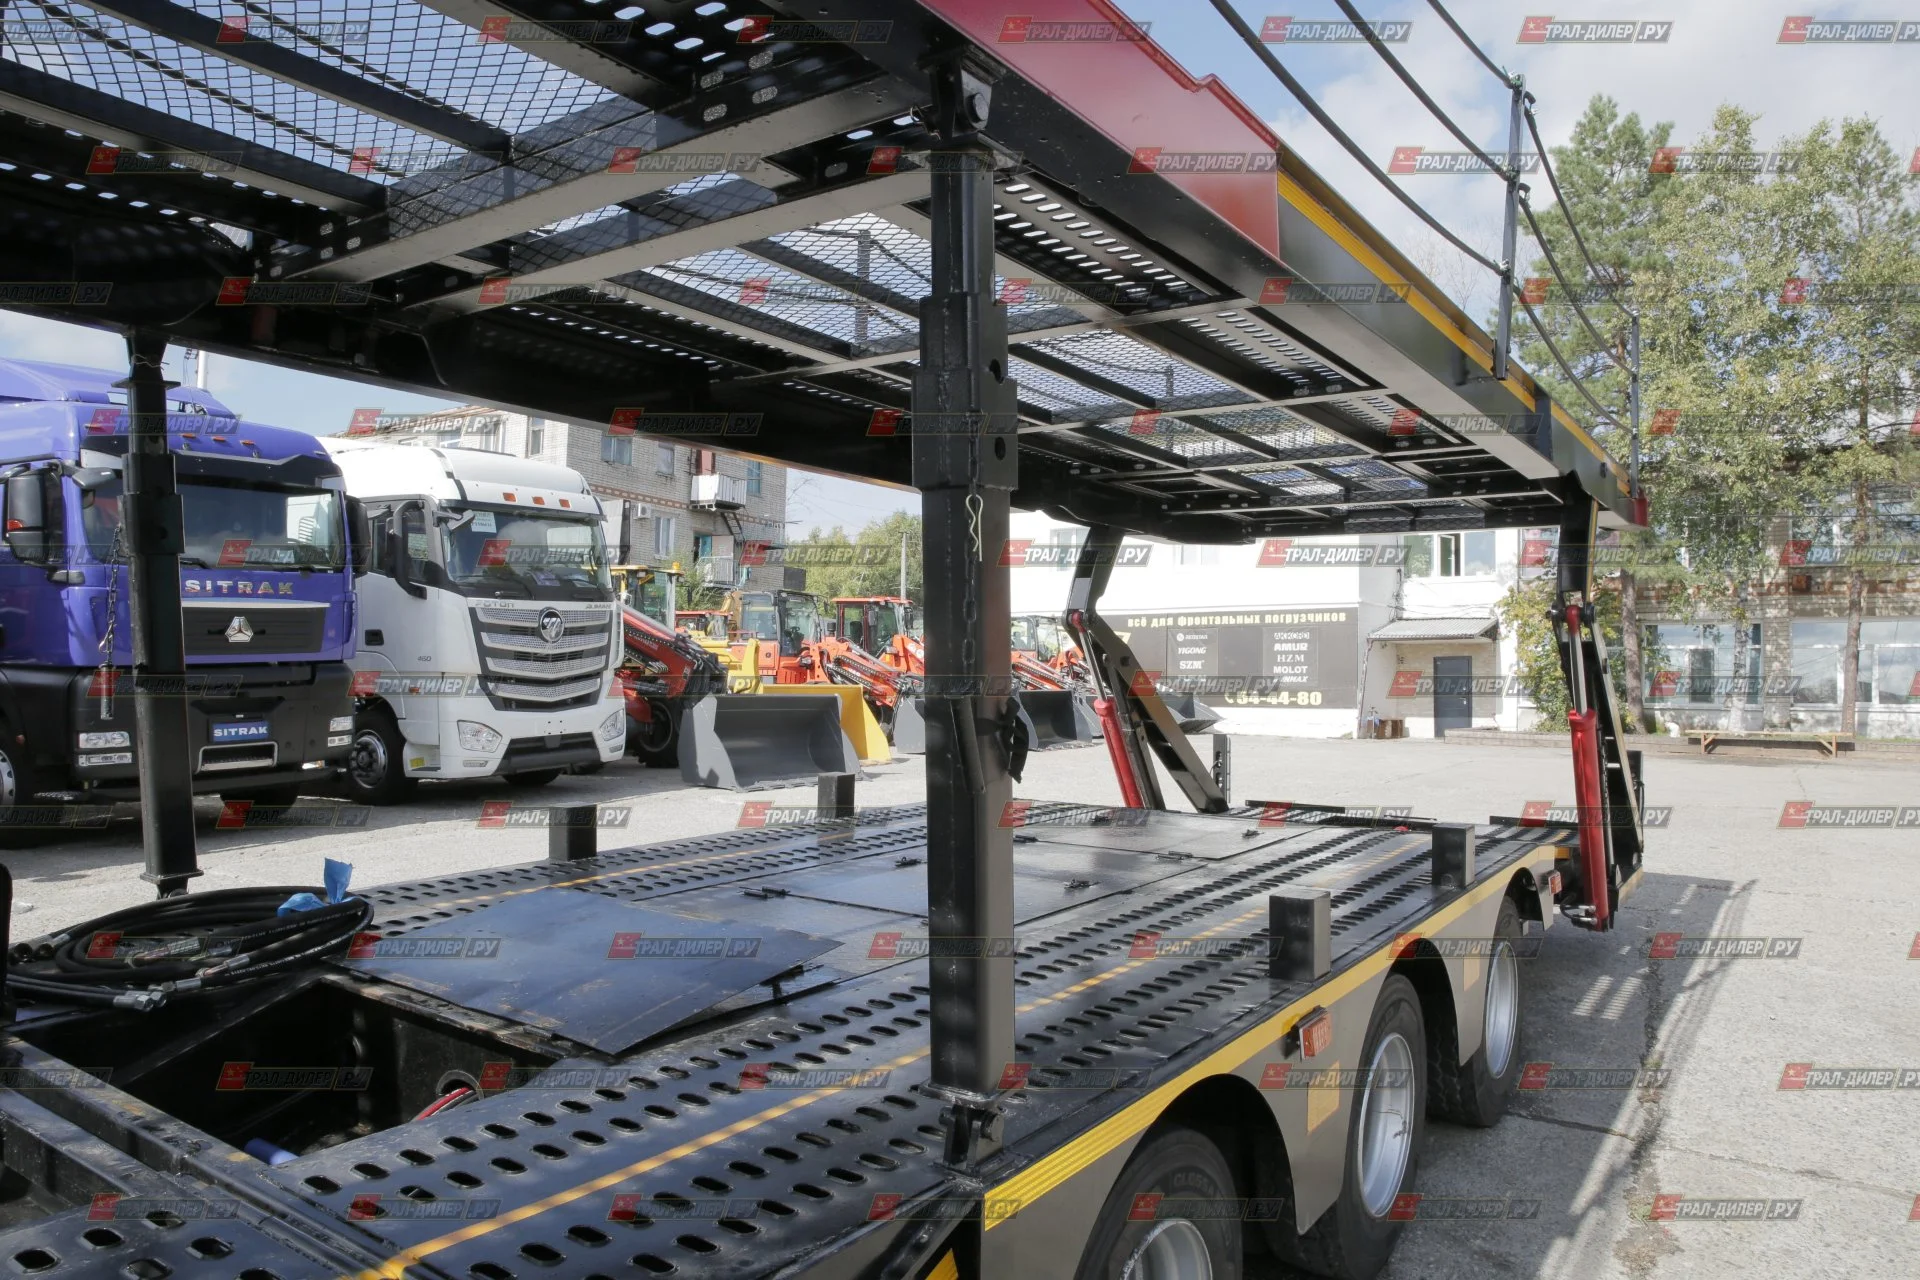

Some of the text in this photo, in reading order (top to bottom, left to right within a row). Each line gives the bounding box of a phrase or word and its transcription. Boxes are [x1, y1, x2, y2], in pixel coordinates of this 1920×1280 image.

[185, 579, 294, 594] SITRAK
[1127, 612, 1346, 628] всё для фронтальных погрузчиков
[1274, 643, 1308, 652] AMUR
[1276, 654, 1305, 663] HZM
[1273, 665, 1308, 674] MOLOT
[1236, 690, 1322, 706] 54-44-80
[213, 726, 268, 737] SITRAK
